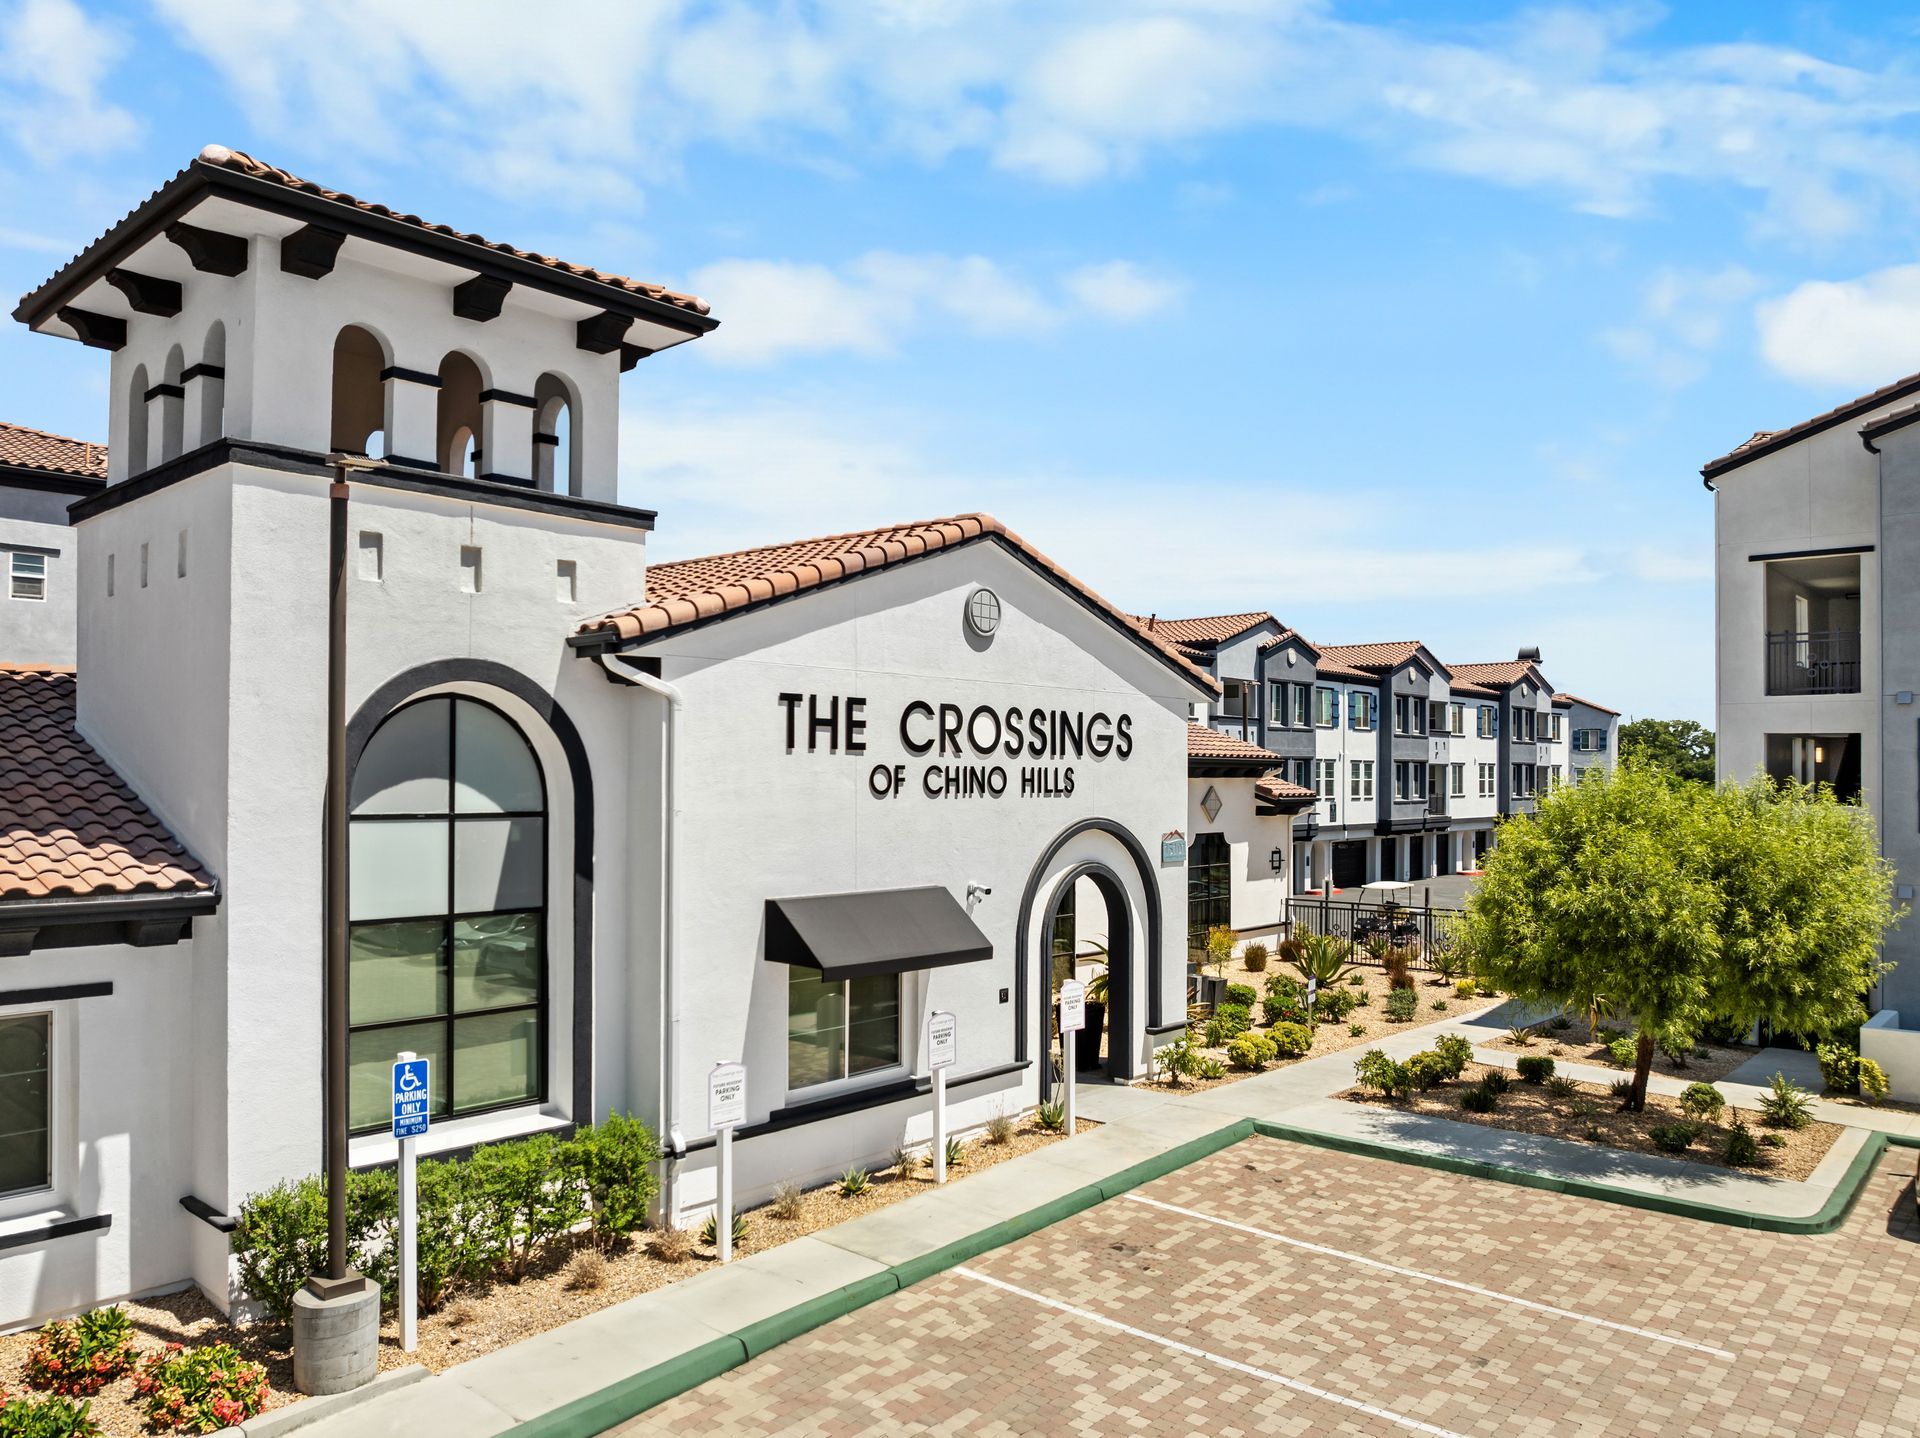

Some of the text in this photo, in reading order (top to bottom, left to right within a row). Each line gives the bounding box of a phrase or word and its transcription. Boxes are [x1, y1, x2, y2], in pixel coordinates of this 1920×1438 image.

[779, 692, 1133, 758] THE CROSSINGS
[869, 764, 1075, 797] OF CHINO HILLS
[1065, 998, 1081, 1006] PARKING
[932, 1031, 952, 1041] PARKING
[936, 1038, 948, 1046] ONLY
[395, 1088, 427, 1104] PARKING
[715, 1085, 741, 1096] PARKING
[720, 1093, 735, 1103] ONLY
[401, 1101, 421, 1116] ONLY
[399, 1115, 423, 1127] MINIMUM
[395, 1123, 427, 1136] FINE $250
